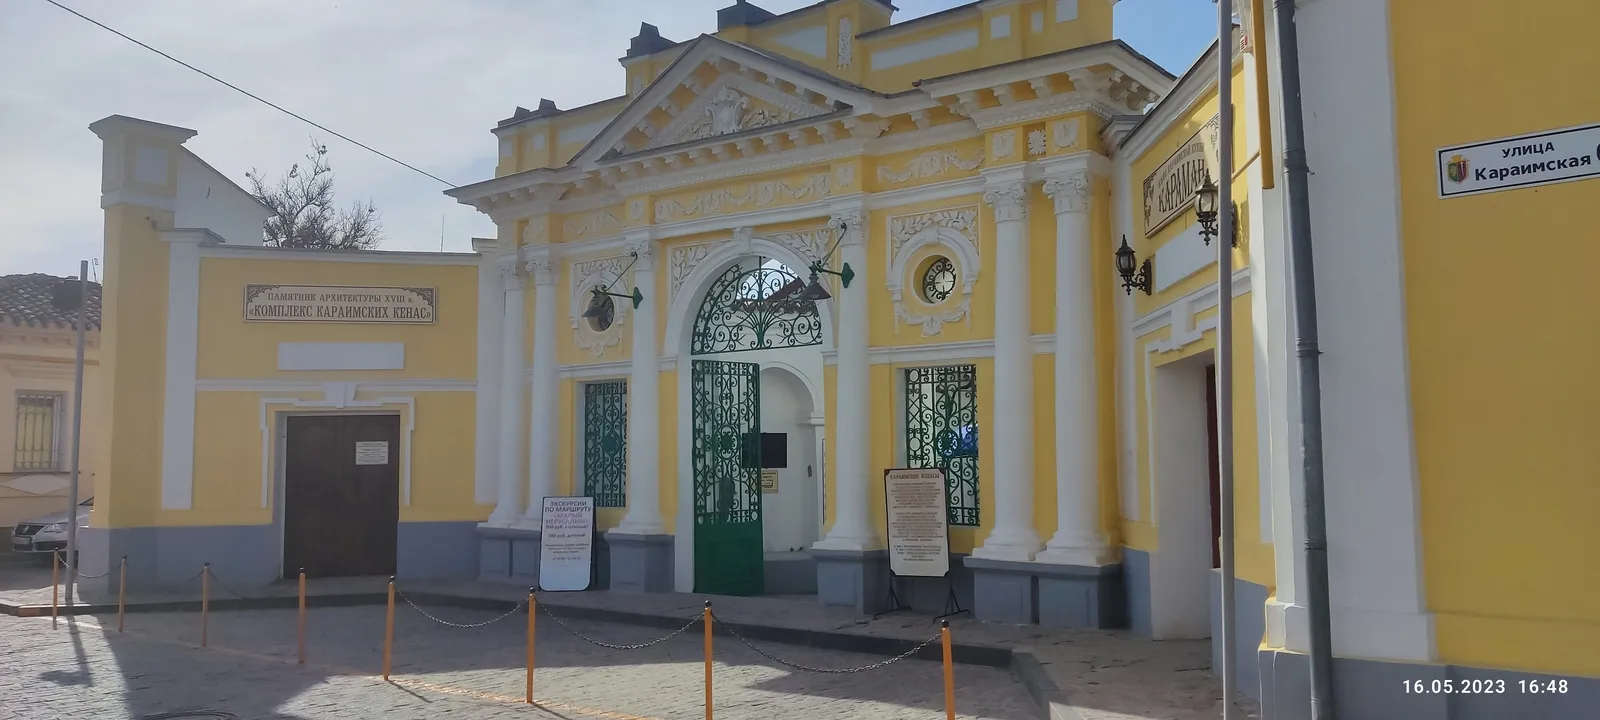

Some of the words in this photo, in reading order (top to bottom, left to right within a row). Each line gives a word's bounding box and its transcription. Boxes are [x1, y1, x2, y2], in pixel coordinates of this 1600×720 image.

[1501, 141, 1555, 158] УЛИЦА
[1474, 154, 1592, 181] Караимская
[1159, 159, 1205, 213] КАРАМАН
[267, 292, 316, 302] ПАМЯТНИК
[319, 293, 381, 303] АРХИТЕКТУРЫ
[384, 294, 405, 303] XVIII
[248, 304, 313, 317] «КОМПЛЕКС
[316, 305, 389, 319] КАРАИМСКИХ
[392, 307, 431, 319] КЕНАС»
